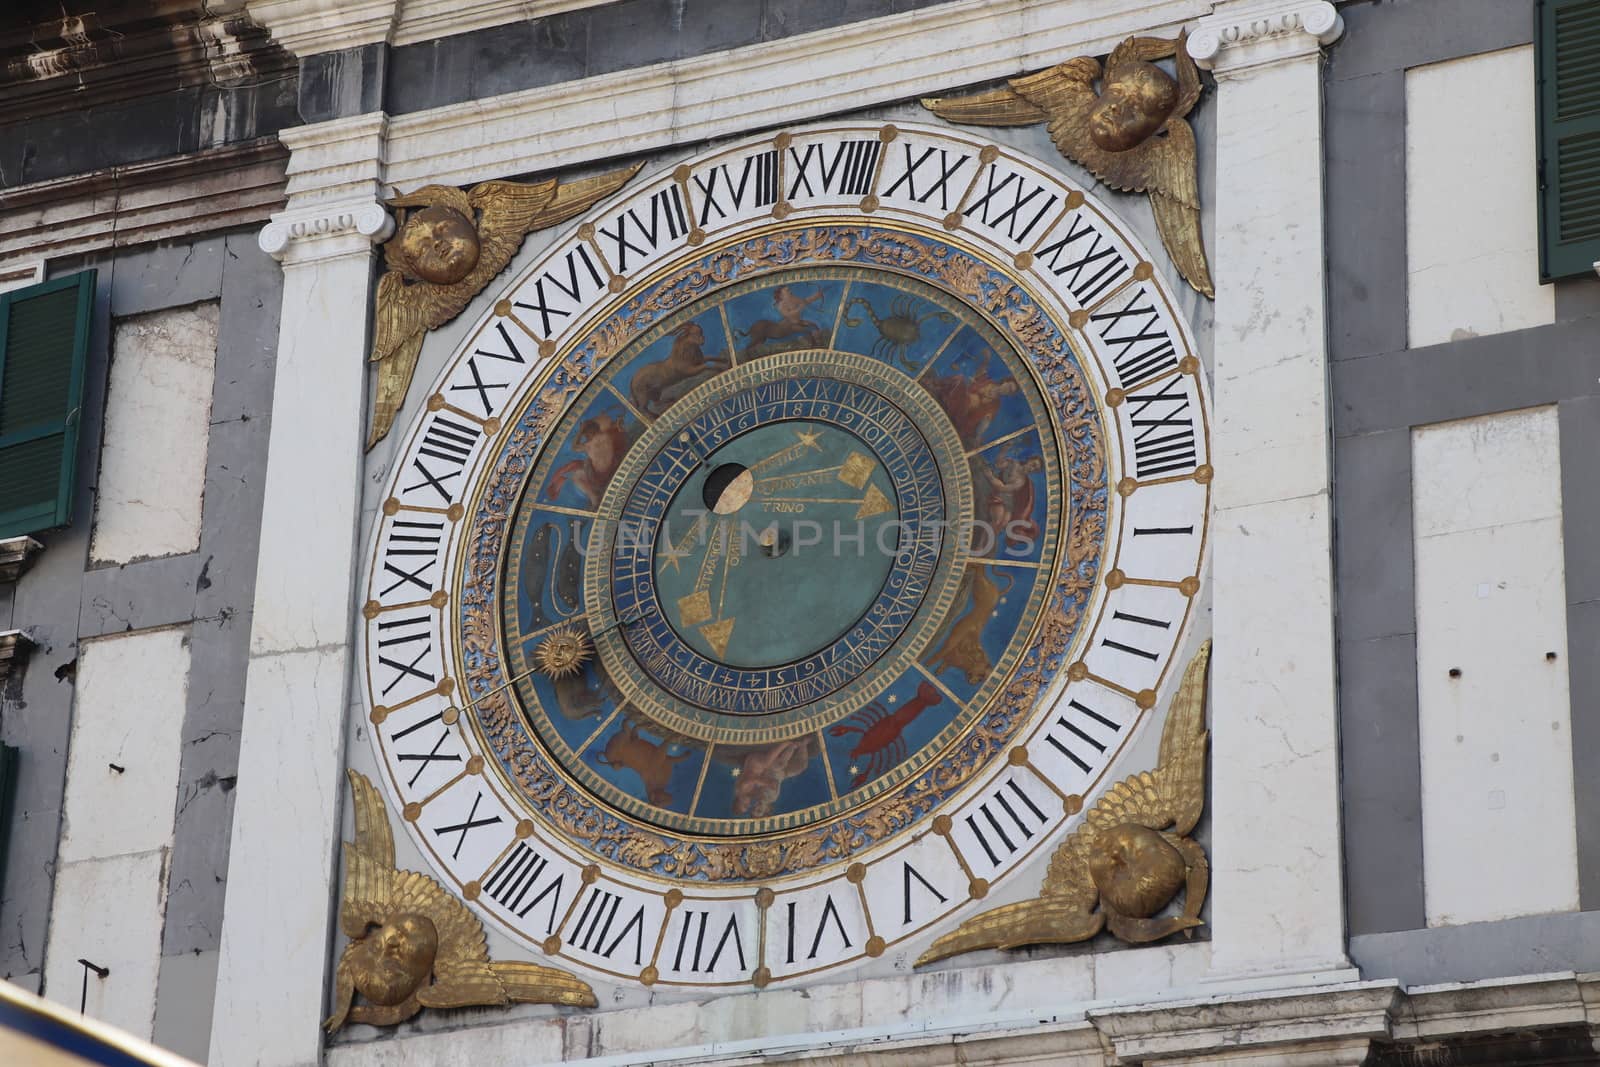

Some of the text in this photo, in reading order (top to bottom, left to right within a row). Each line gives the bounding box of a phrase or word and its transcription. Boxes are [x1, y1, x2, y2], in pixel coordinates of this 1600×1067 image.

[378, 140, 1196, 972] I II III IIII V VI VII VIII VIIII X XI XII XIII XIIII XV XVI XVII XVIII XVIIII XX XXI XXII XXIII XXIIII
